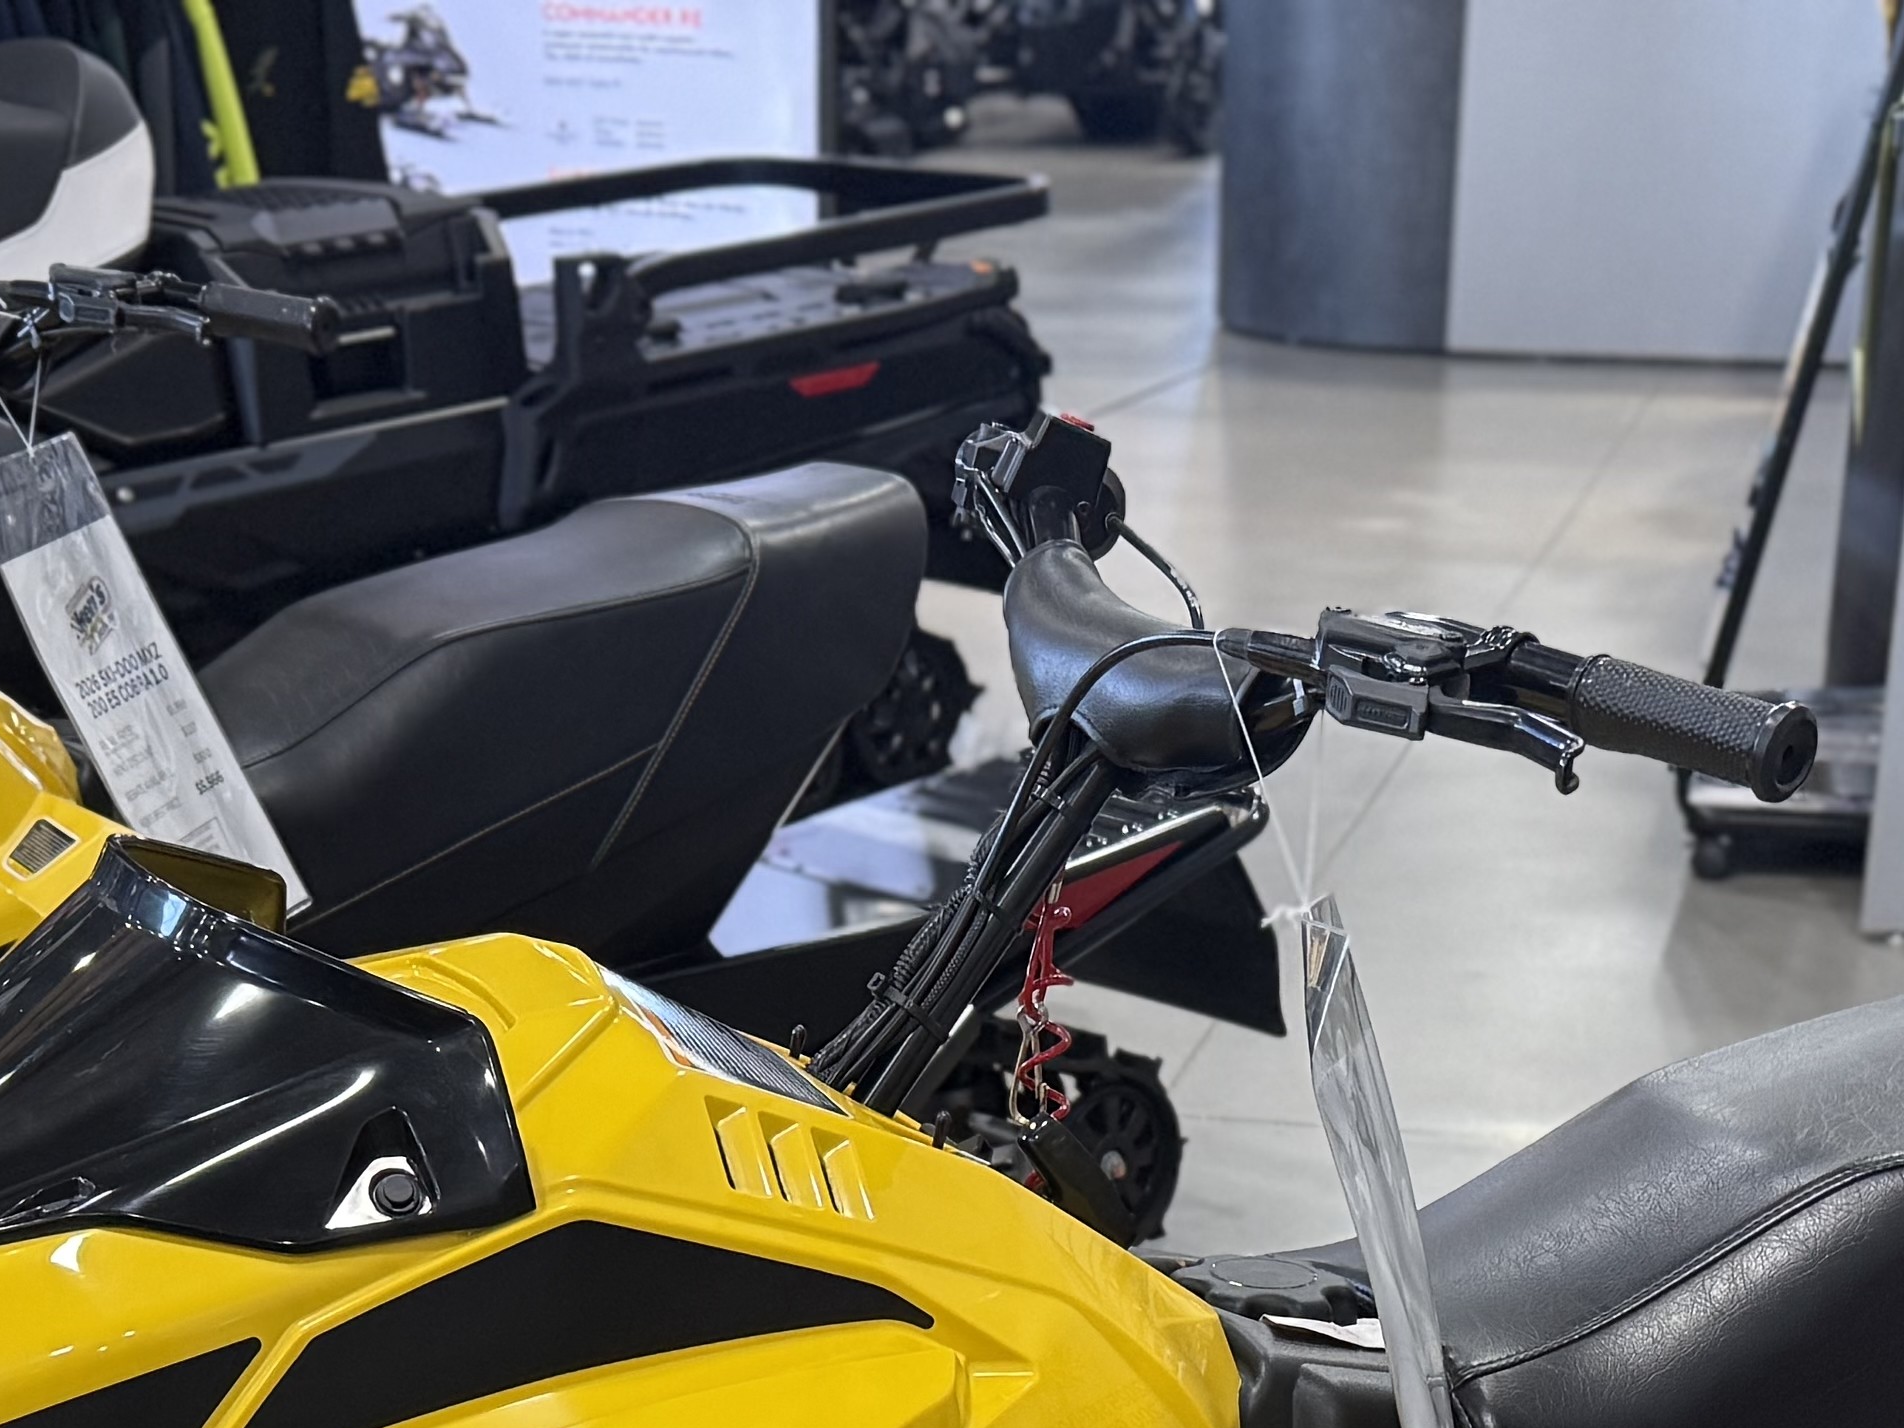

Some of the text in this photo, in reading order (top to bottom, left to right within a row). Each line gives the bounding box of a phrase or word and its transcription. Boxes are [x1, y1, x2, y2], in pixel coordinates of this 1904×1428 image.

[76, 641, 163, 699] 2026 SKI-DOO MXZ
[88, 696, 108, 719] 200
[105, 690, 121, 709] ES
